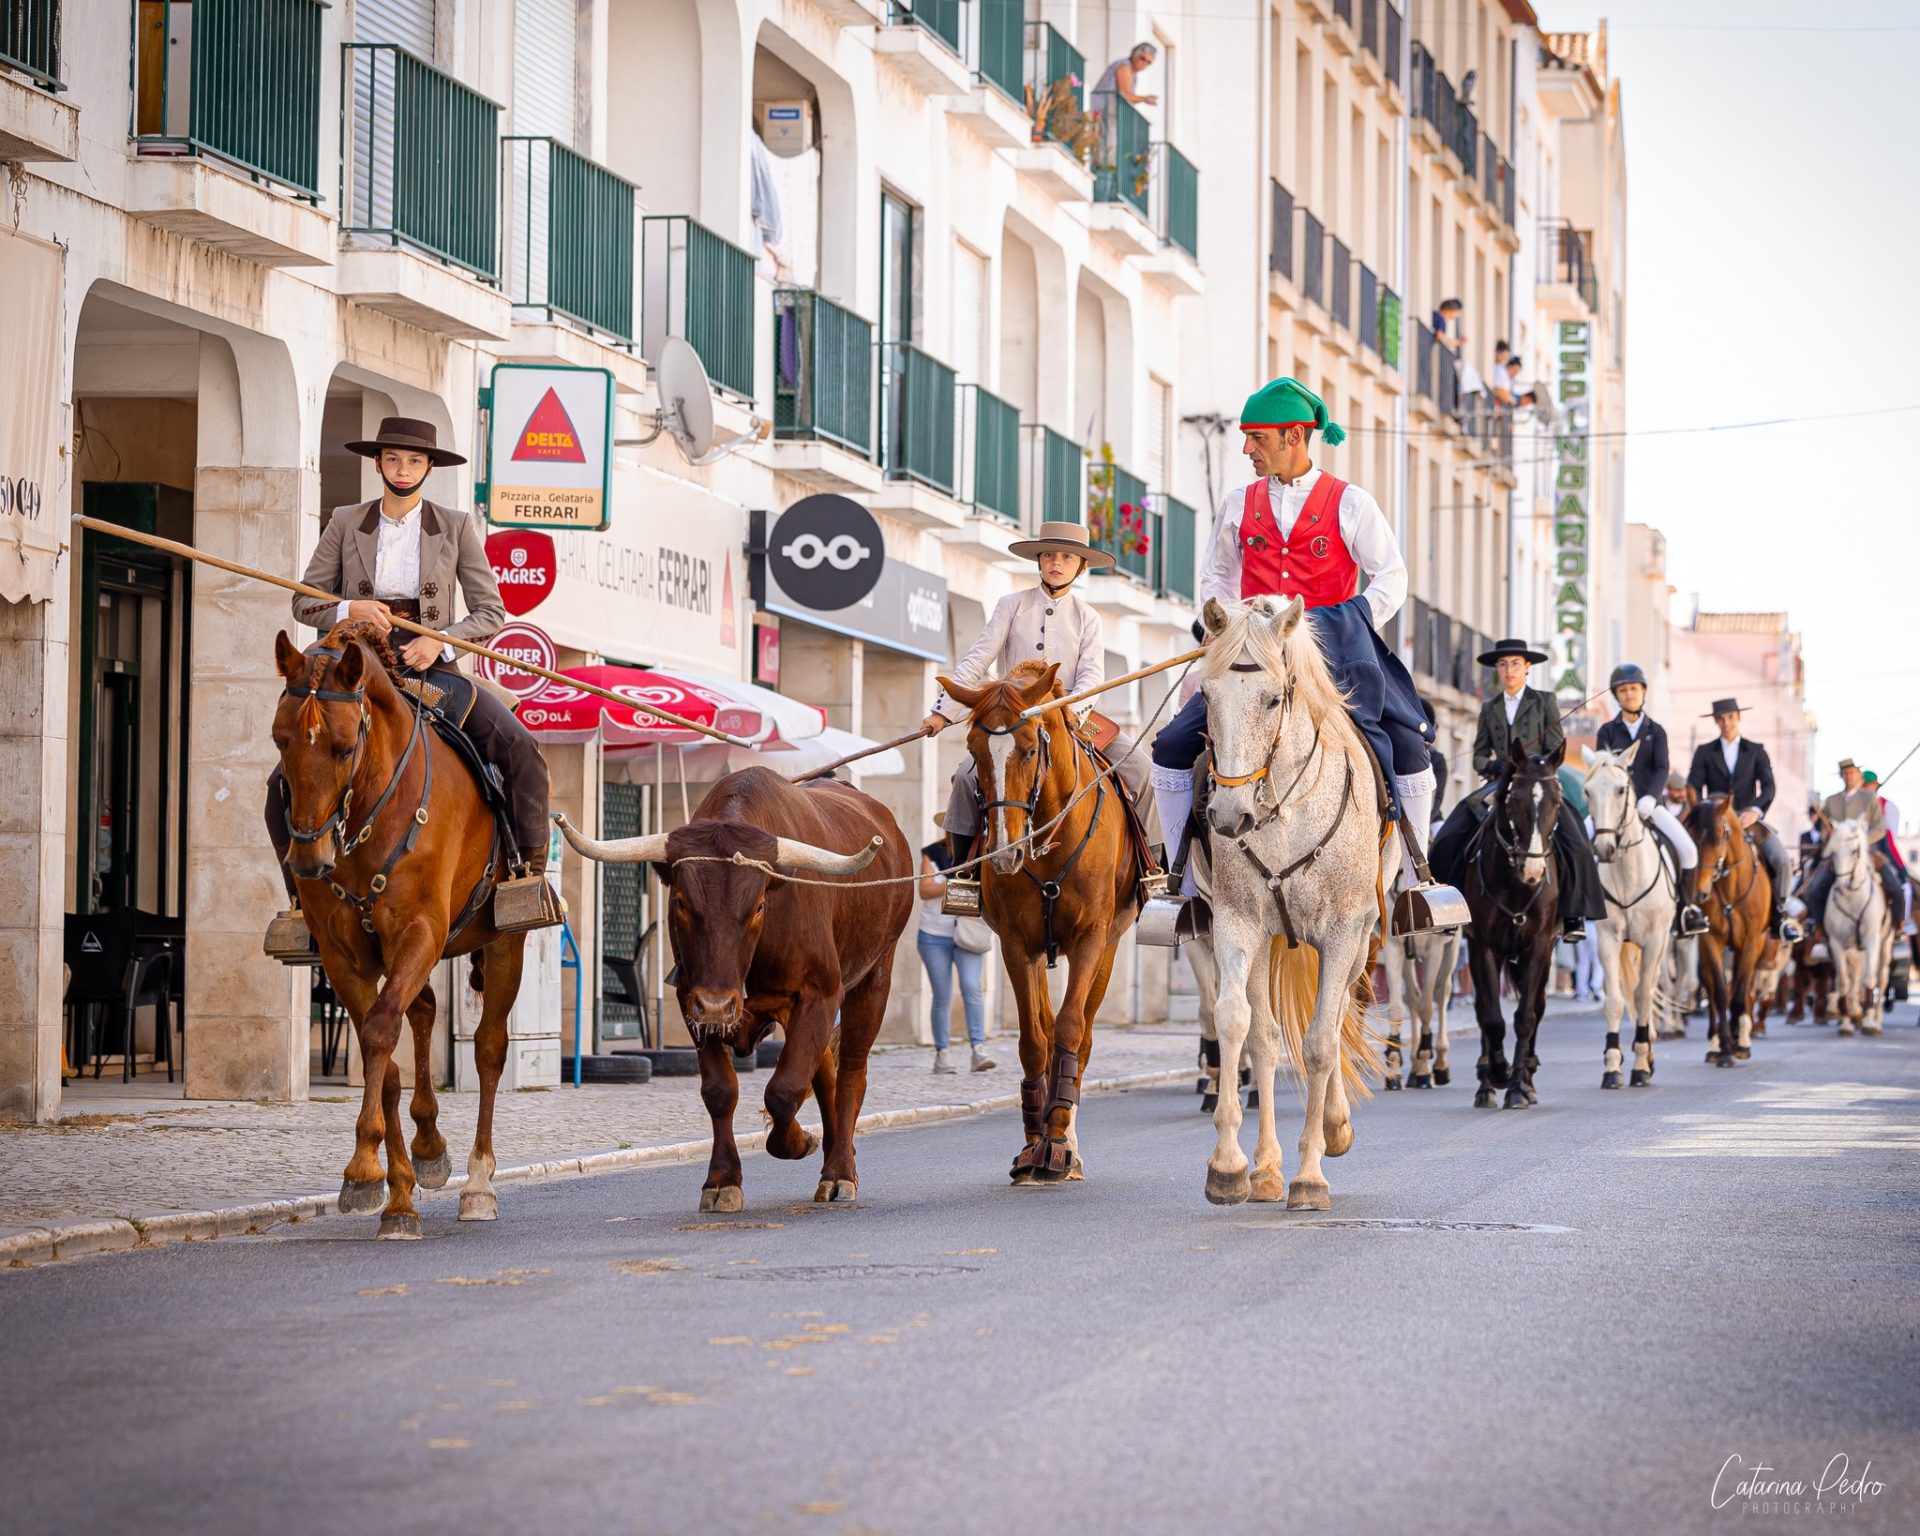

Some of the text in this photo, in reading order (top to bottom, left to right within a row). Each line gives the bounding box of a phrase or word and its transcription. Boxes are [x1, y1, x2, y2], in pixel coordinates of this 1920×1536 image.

[526, 431, 574, 448] DELTA
[500, 491, 594, 504] Pizzaria Gelataria
[514, 504, 579, 519] FERRARI
[490, 565, 546, 586] SAGRES
[598, 539, 655, 601] GELATARIA
[658, 546, 712, 616] FERRARI
[549, 711, 572, 723] OLÁ
